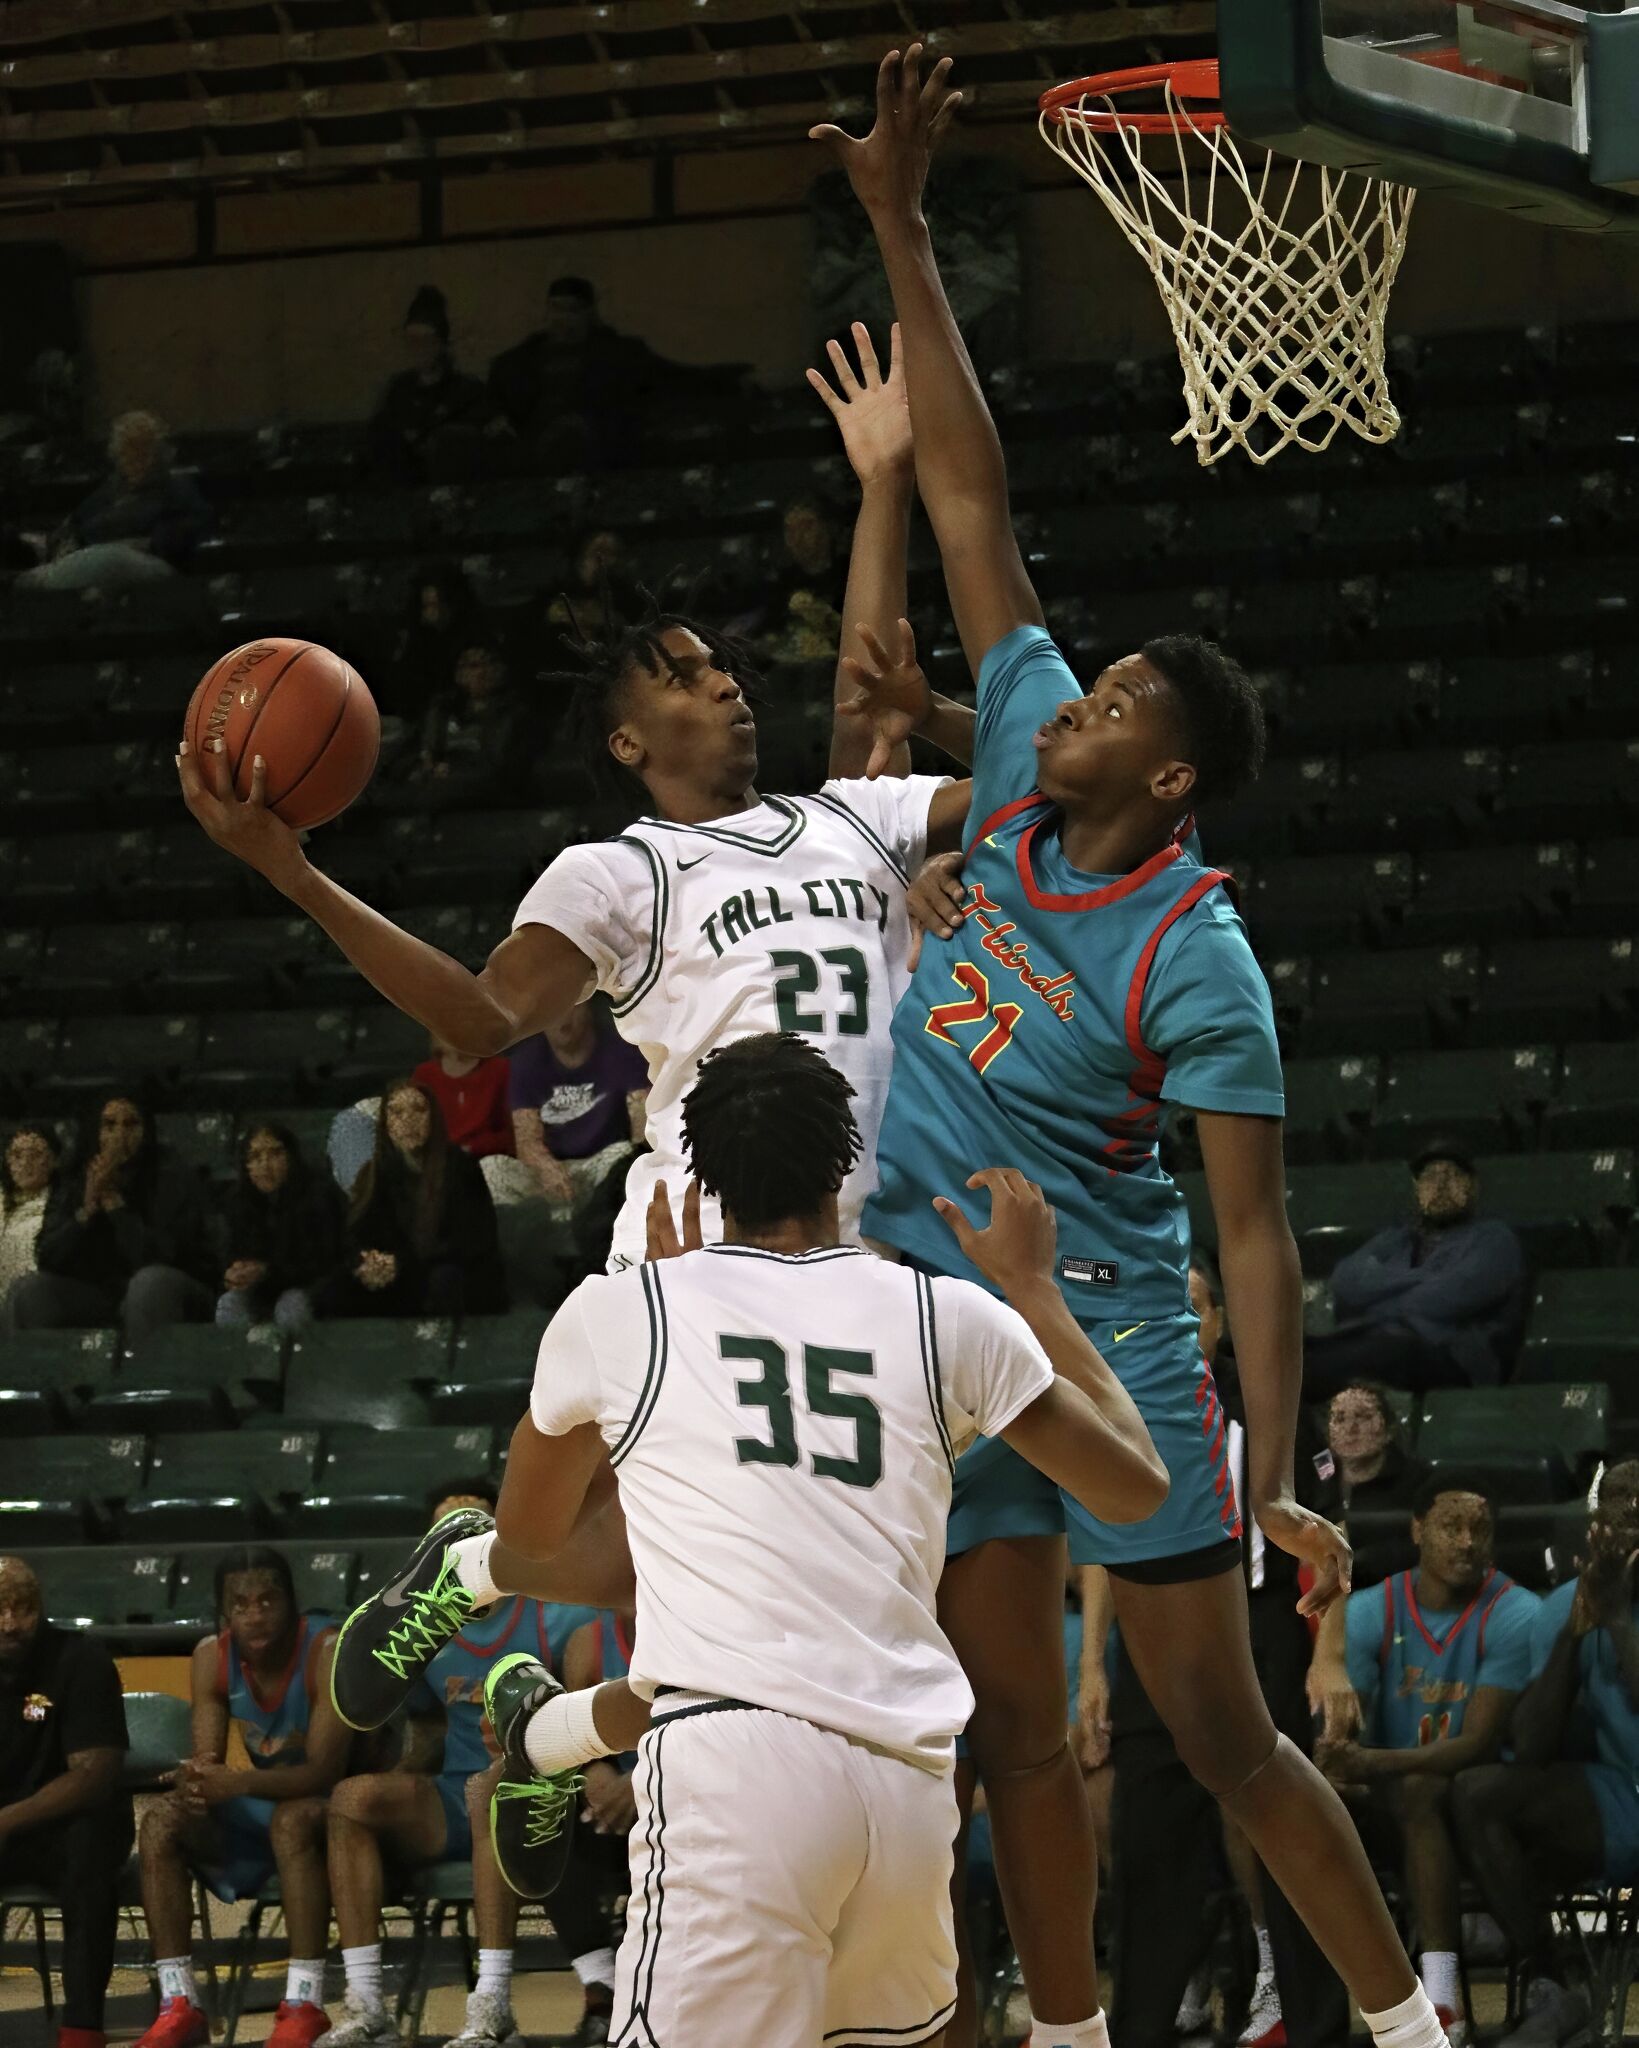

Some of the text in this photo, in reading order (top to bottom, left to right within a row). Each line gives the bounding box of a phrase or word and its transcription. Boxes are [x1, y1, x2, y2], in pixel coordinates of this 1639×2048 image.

[699, 877, 890, 959] TALL CITY
[765, 944, 870, 1039] 23
[924, 961, 1025, 1076] 21
[1097, 1268, 1112, 1280] XL
[715, 1331, 886, 1491] 35
